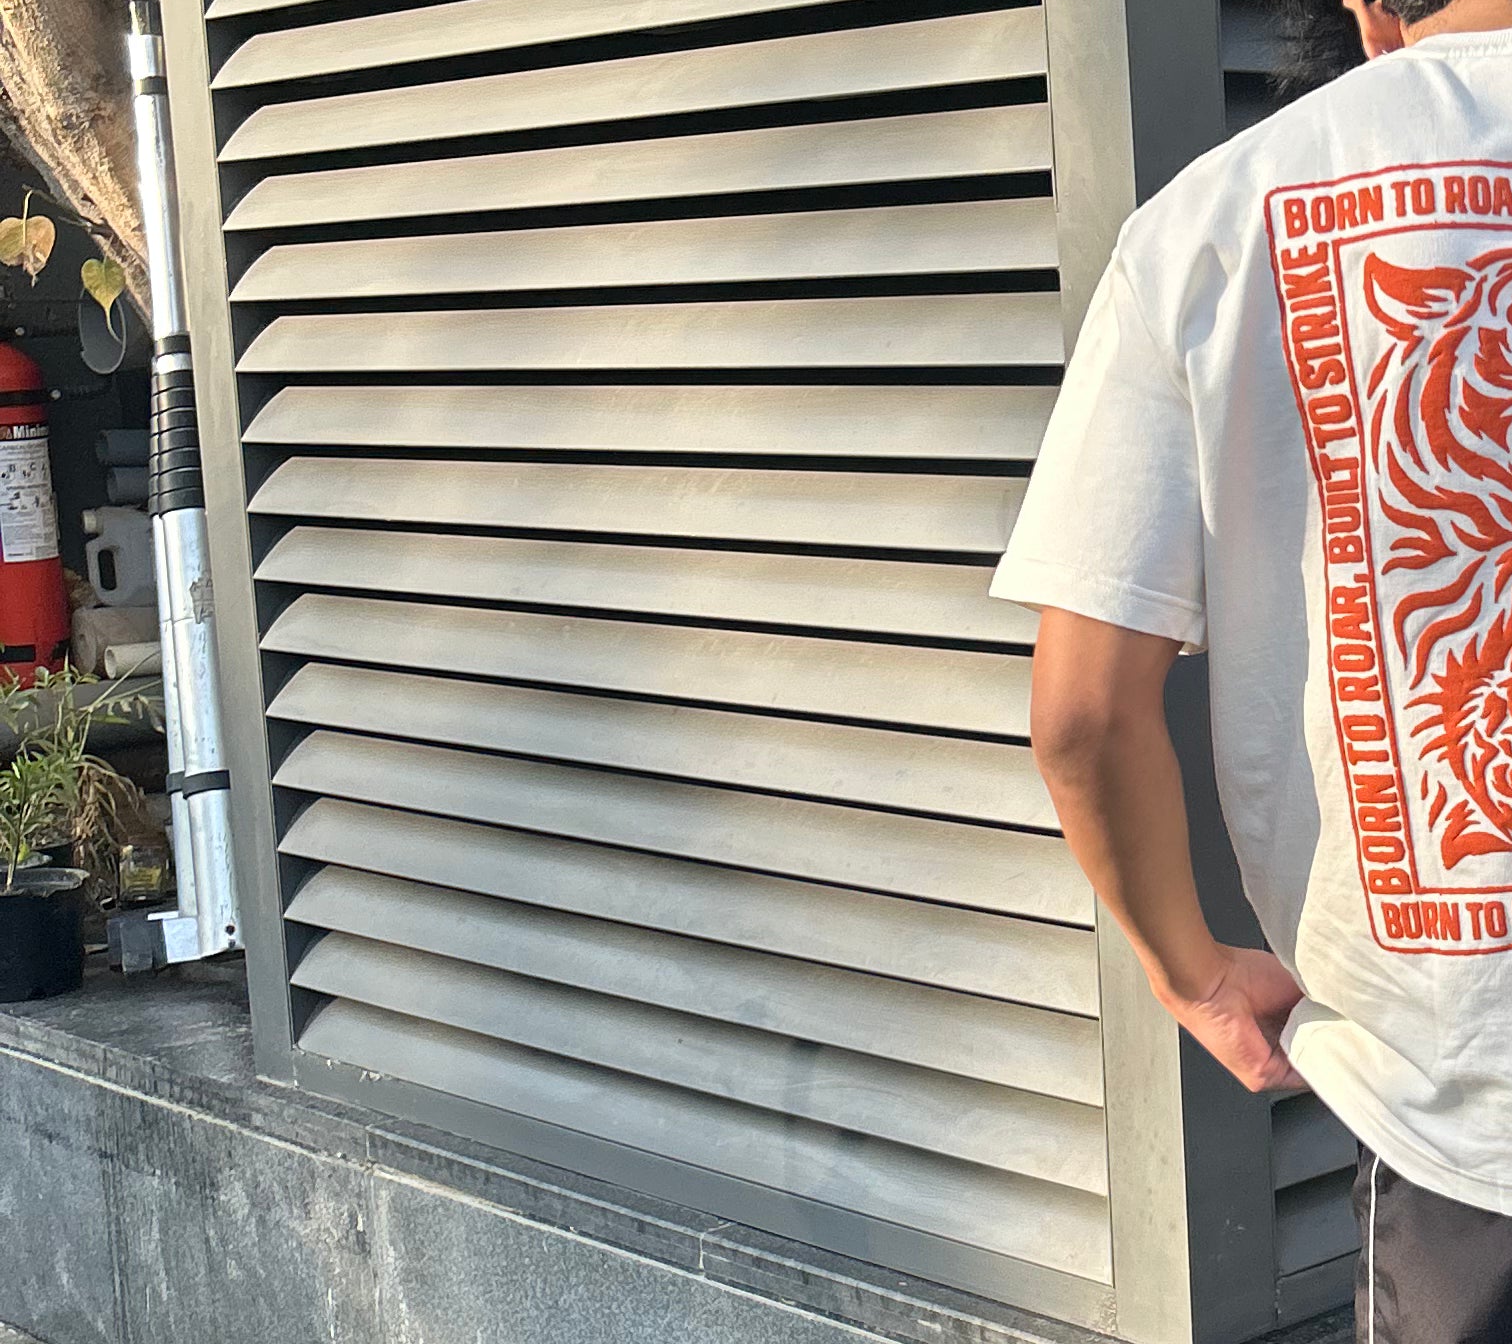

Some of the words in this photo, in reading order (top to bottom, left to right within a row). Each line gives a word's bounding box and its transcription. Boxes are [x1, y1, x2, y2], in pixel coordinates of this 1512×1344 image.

[1283, 187, 1382, 239] BORN
[1393, 177, 1436, 217] TO
[1280, 240, 1347, 391] STRIKE
[1307, 393, 1358, 449] TO
[1318, 452, 1365, 565] BUILT
[1330, 573, 1375, 703] ROAR,
[1342, 714, 1390, 767] TO
[1353, 773, 1413, 895] BORN
[1381, 899, 1461, 941] BORN
[1464, 900, 1501, 938] TO
